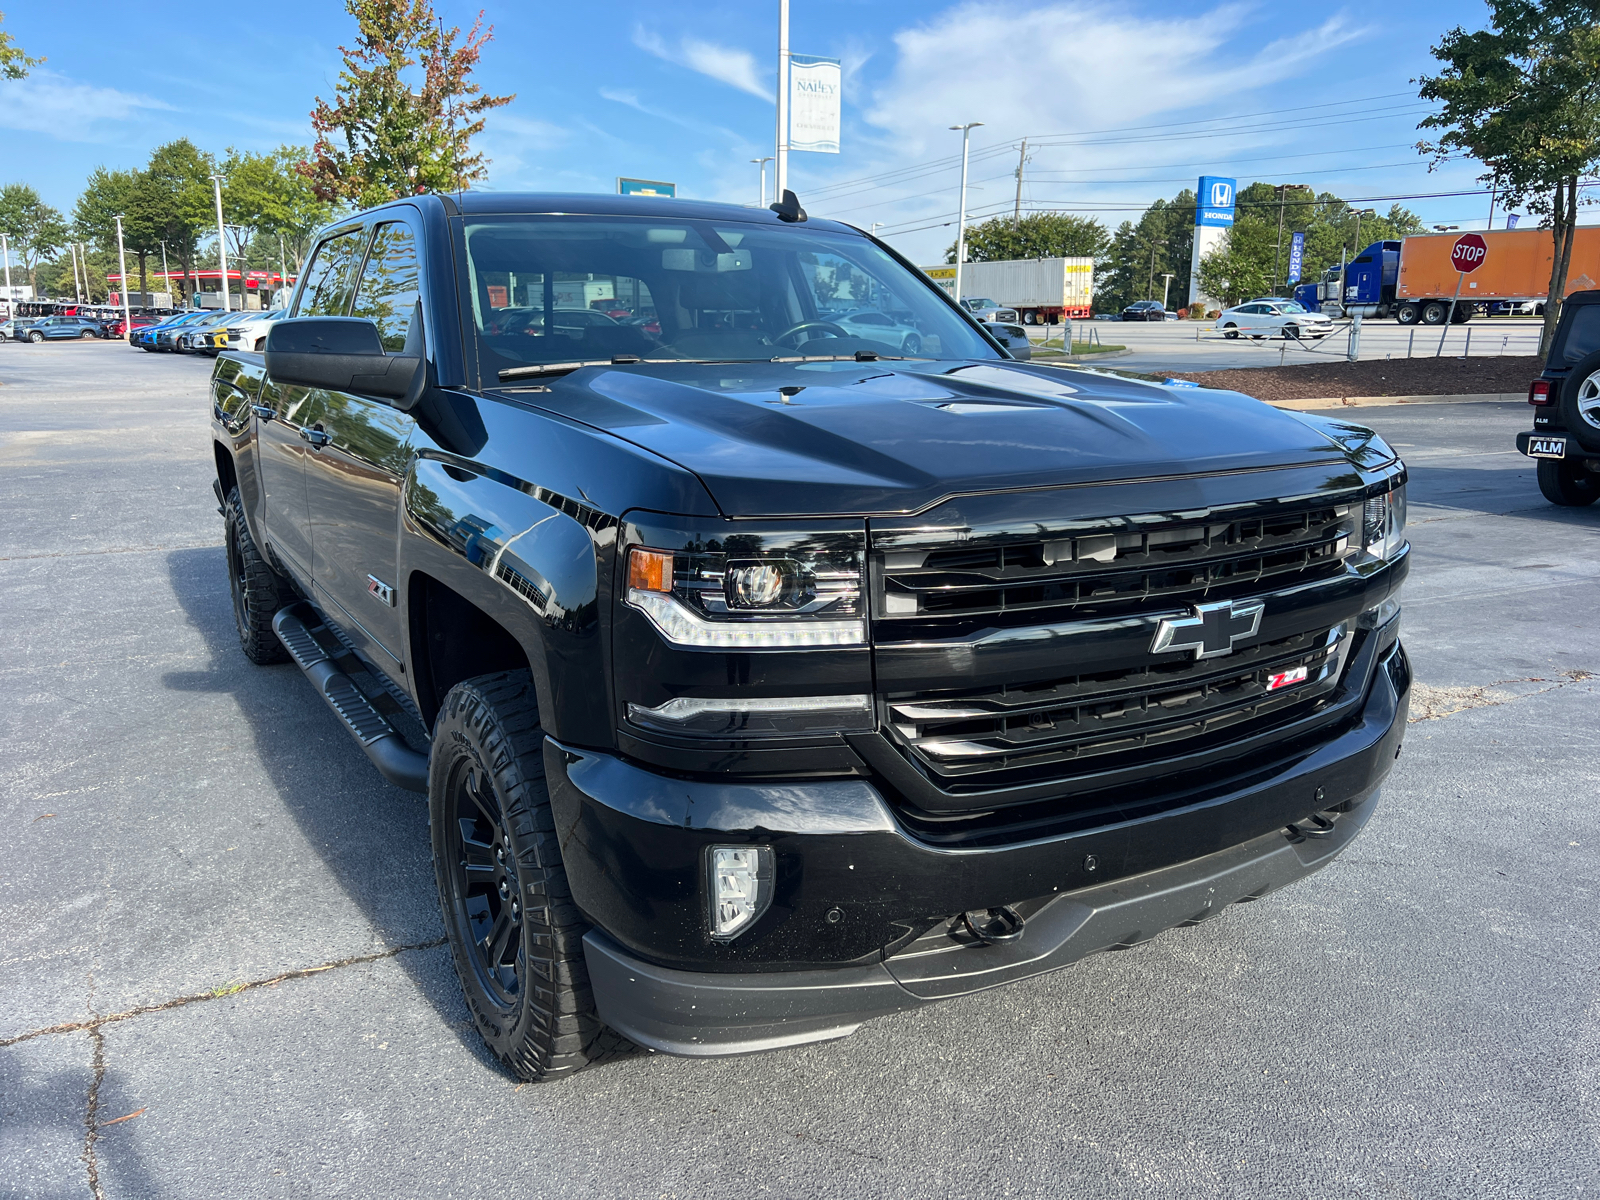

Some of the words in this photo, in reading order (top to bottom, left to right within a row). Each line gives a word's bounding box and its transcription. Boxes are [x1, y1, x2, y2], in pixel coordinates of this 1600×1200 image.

[1204, 212, 1233, 220] HONDA
[1290, 245, 1302, 276] HONDA
[1453, 244, 1485, 262] STOP
[1532, 441, 1562, 453] ALM
[1266, 666, 1308, 691] Z71
